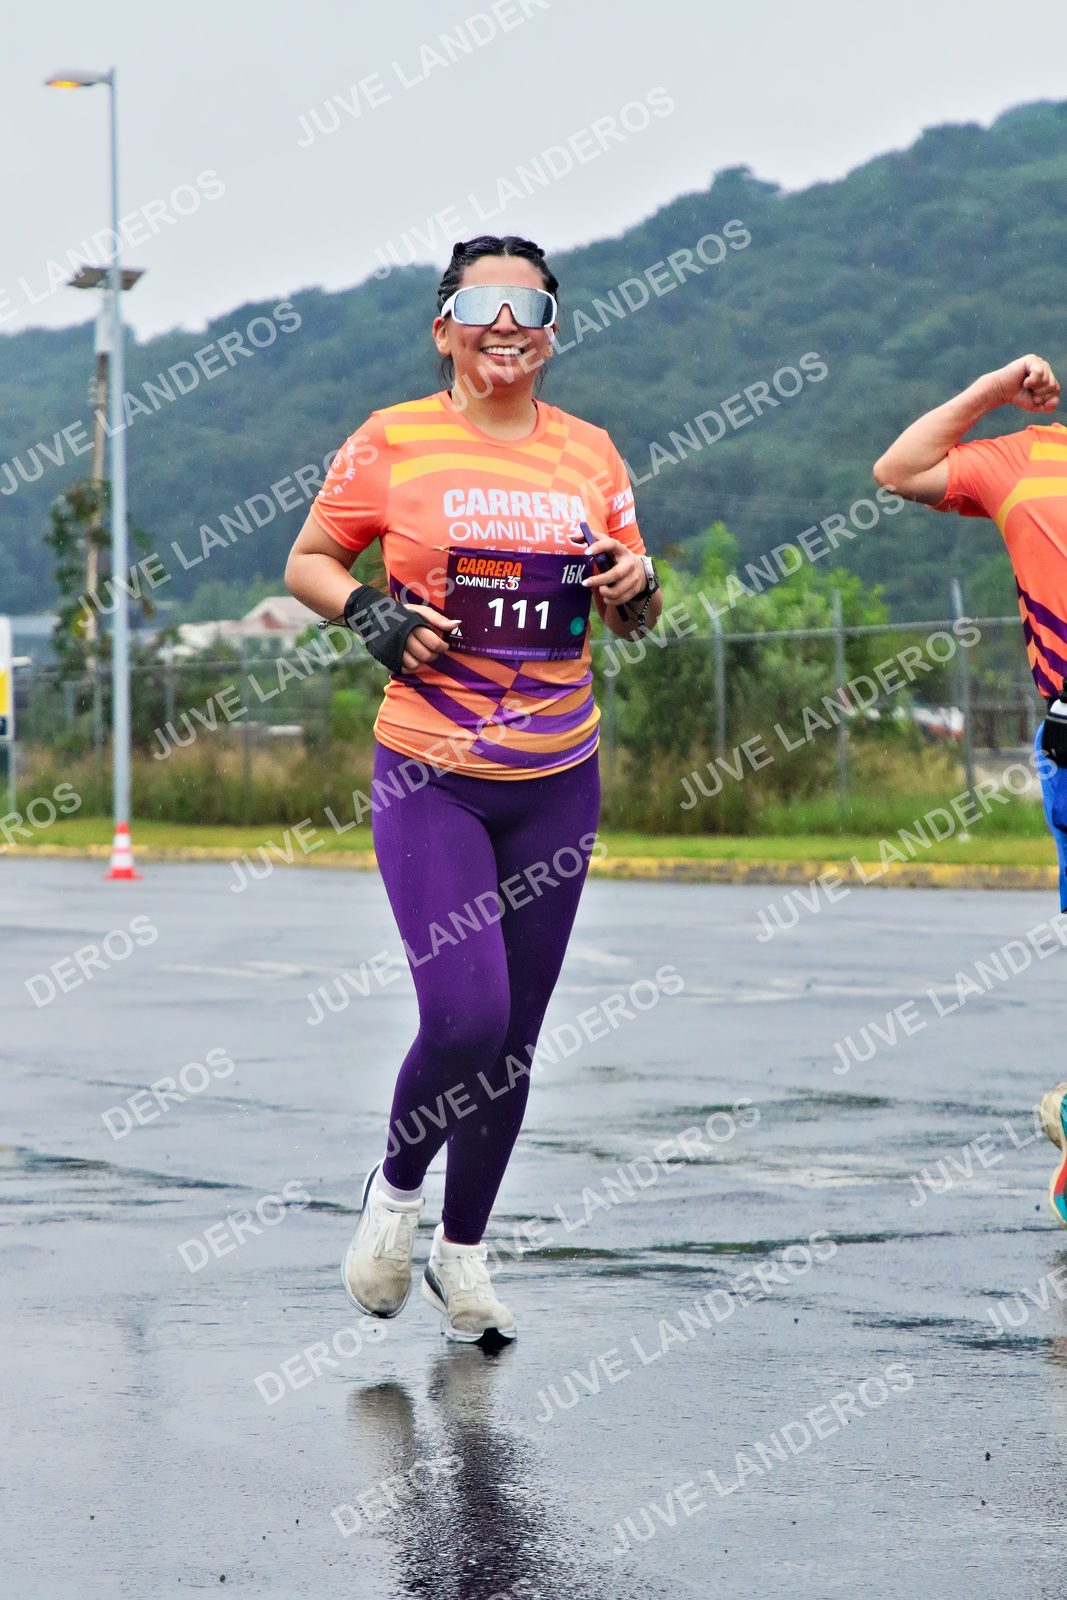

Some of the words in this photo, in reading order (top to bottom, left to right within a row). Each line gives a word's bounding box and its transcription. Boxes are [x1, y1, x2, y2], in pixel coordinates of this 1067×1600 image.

[444, 488, 587, 522] CARRERA
[456, 557, 523, 578] CARRERA
[561, 564, 586, 584] 15K
[488, 598, 550, 630] 111
